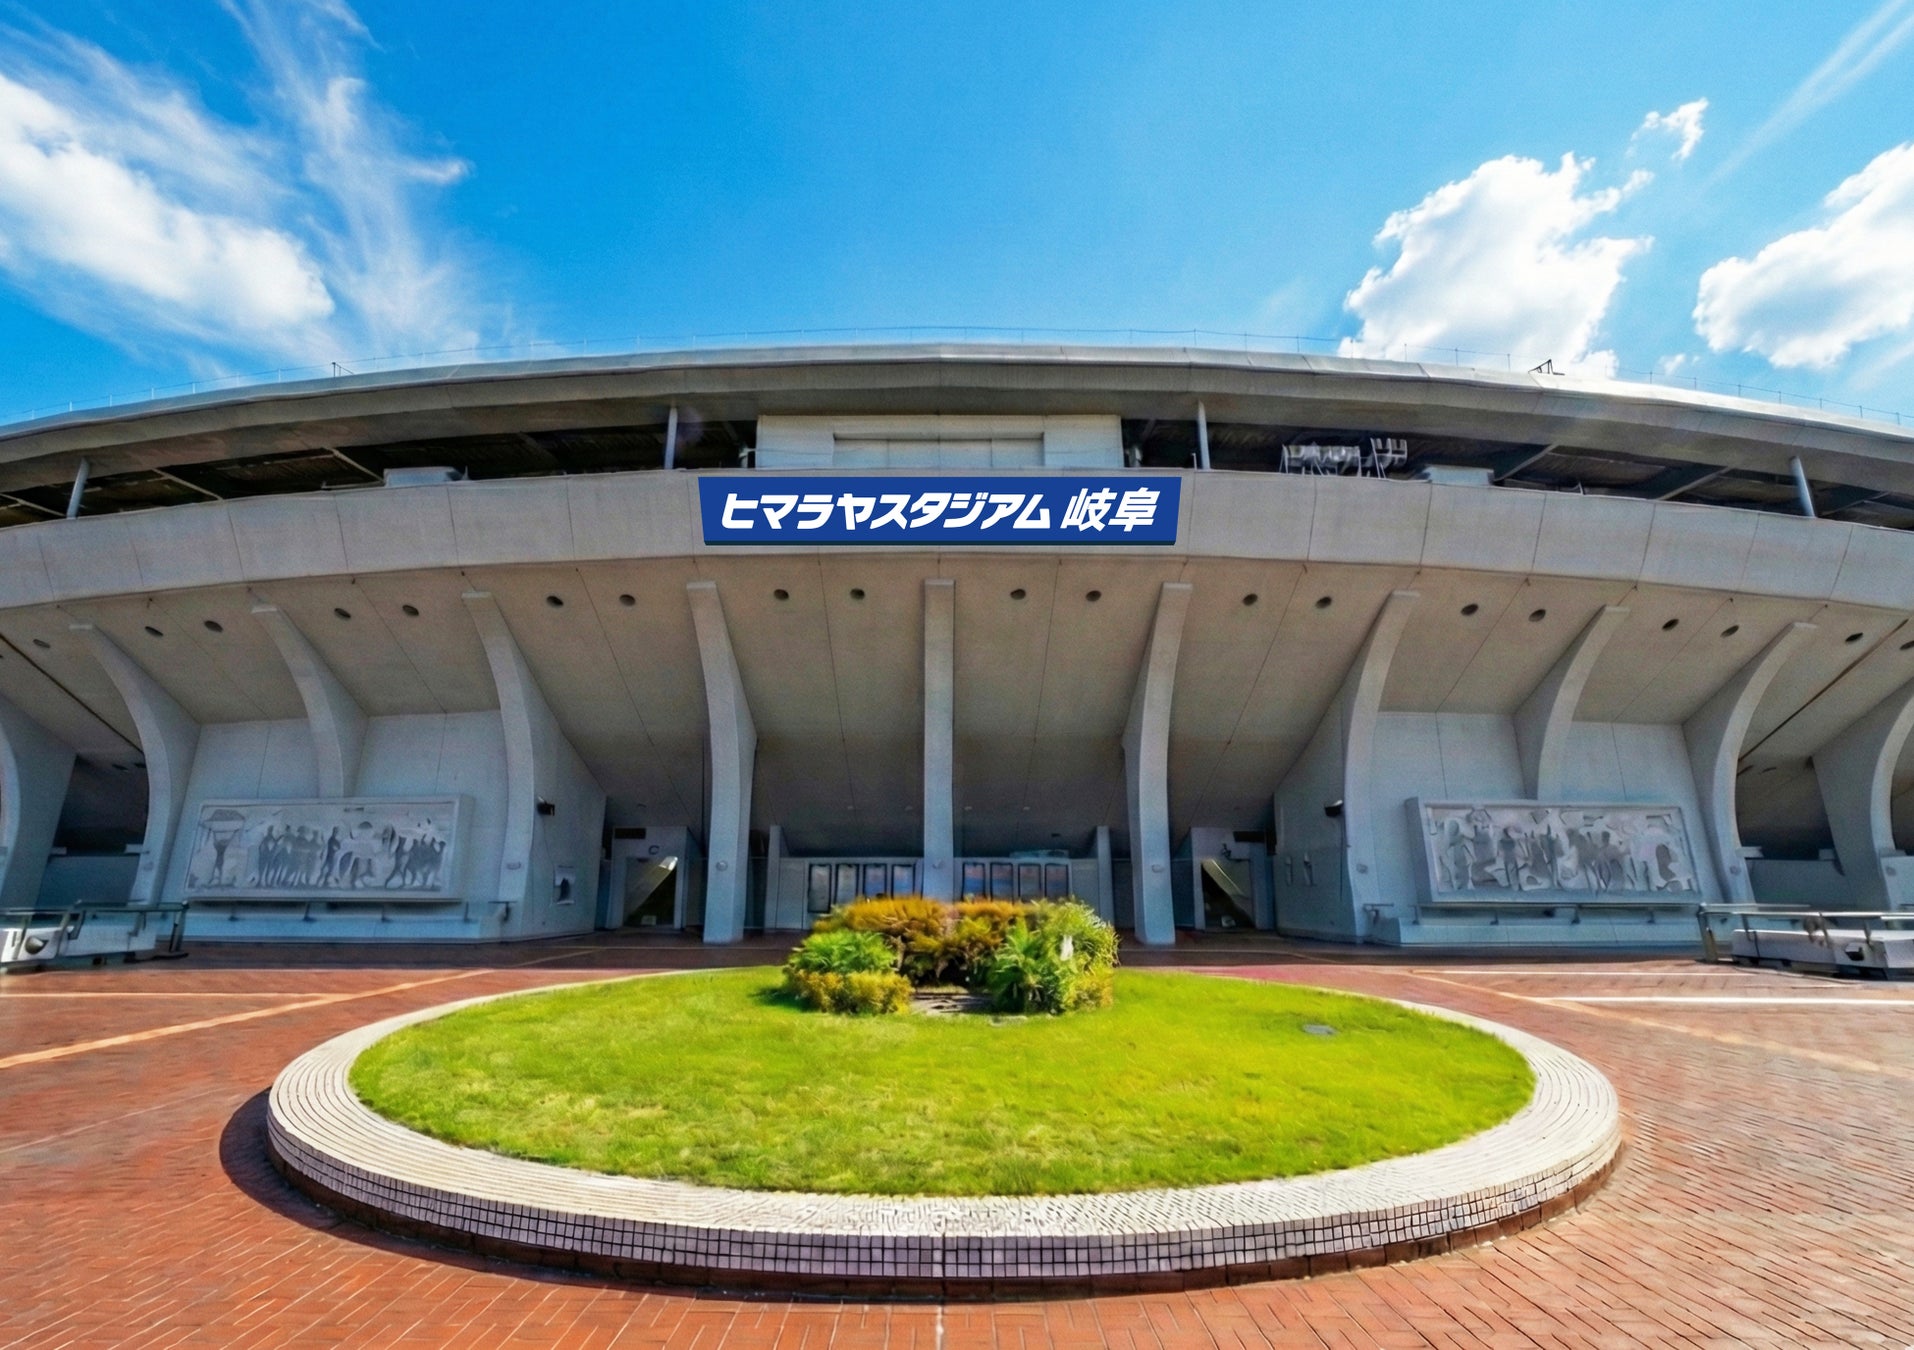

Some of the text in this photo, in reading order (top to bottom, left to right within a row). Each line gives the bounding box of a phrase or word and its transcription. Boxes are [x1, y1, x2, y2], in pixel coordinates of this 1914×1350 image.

[722, 487, 1160, 531] ヒマラヤスタジアム 岐阜
